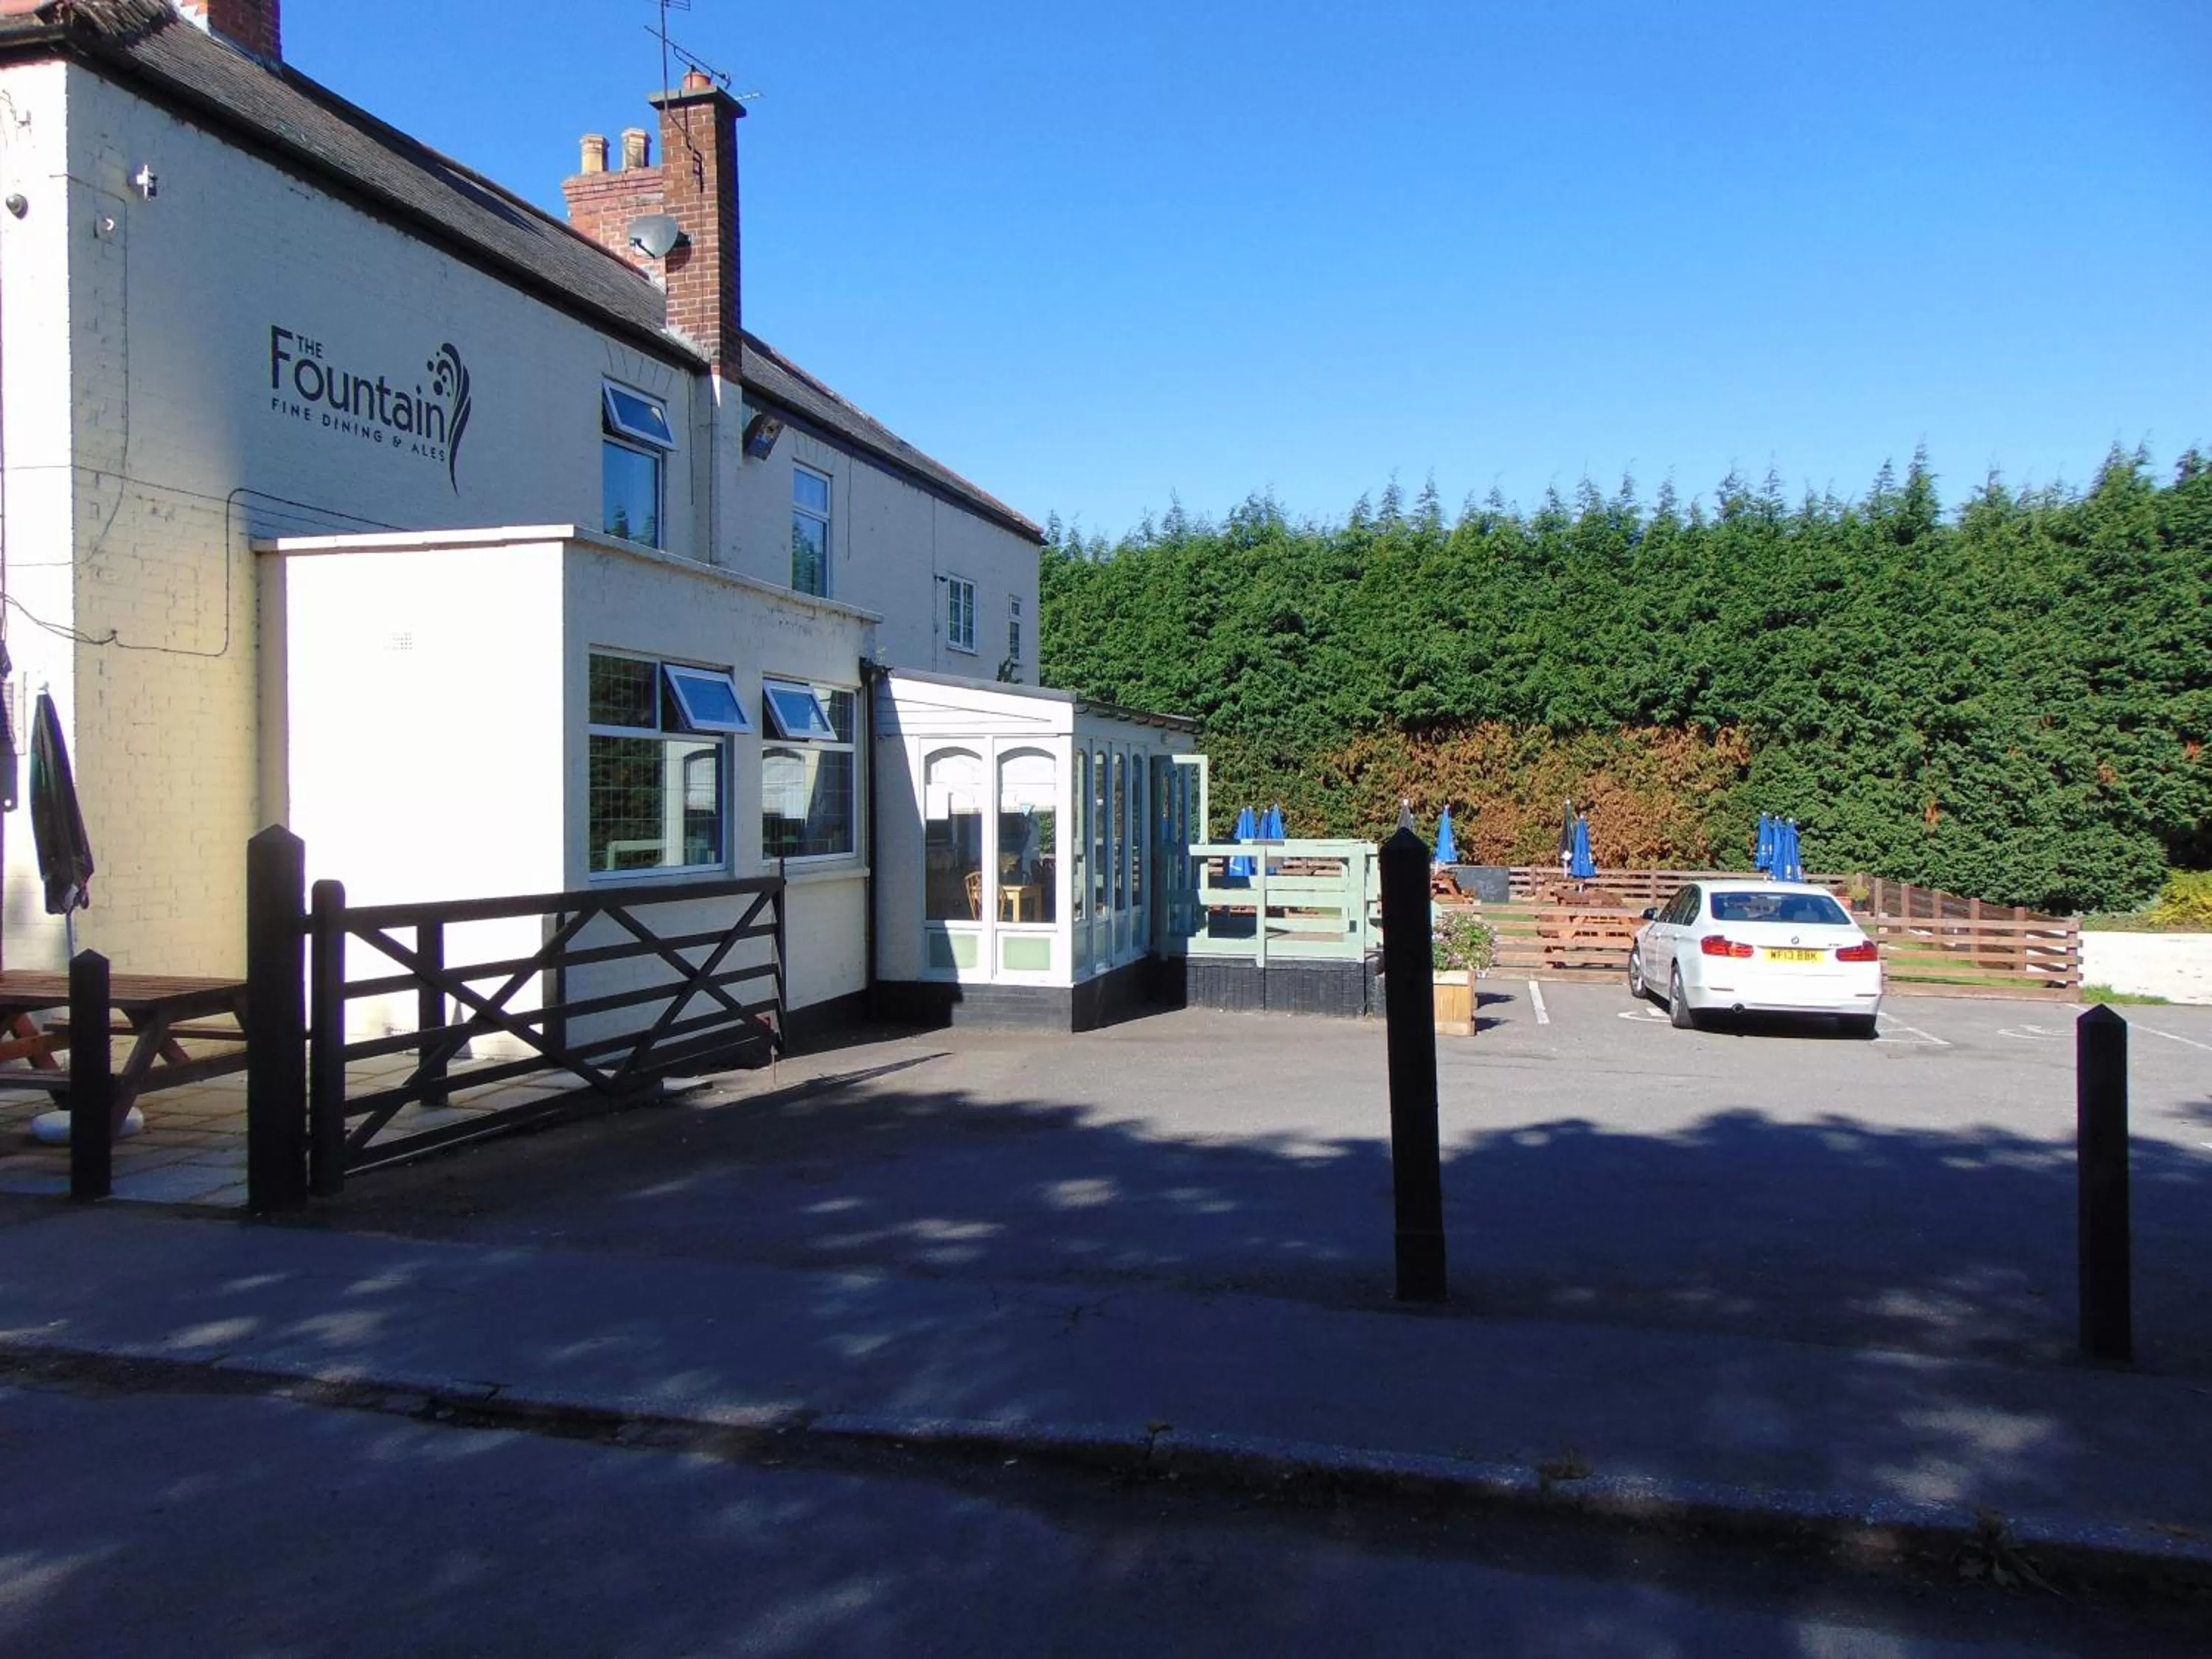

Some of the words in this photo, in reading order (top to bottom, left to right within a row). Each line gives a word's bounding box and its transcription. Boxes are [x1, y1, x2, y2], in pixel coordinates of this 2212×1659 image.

[296, 335, 323, 358] THE
[271, 325, 445, 443] Fountain
[271, 397, 311, 421] FINE
[322, 413, 383, 442] DINING
[392, 436, 402, 448] &
[411, 443, 445, 462] ALES
